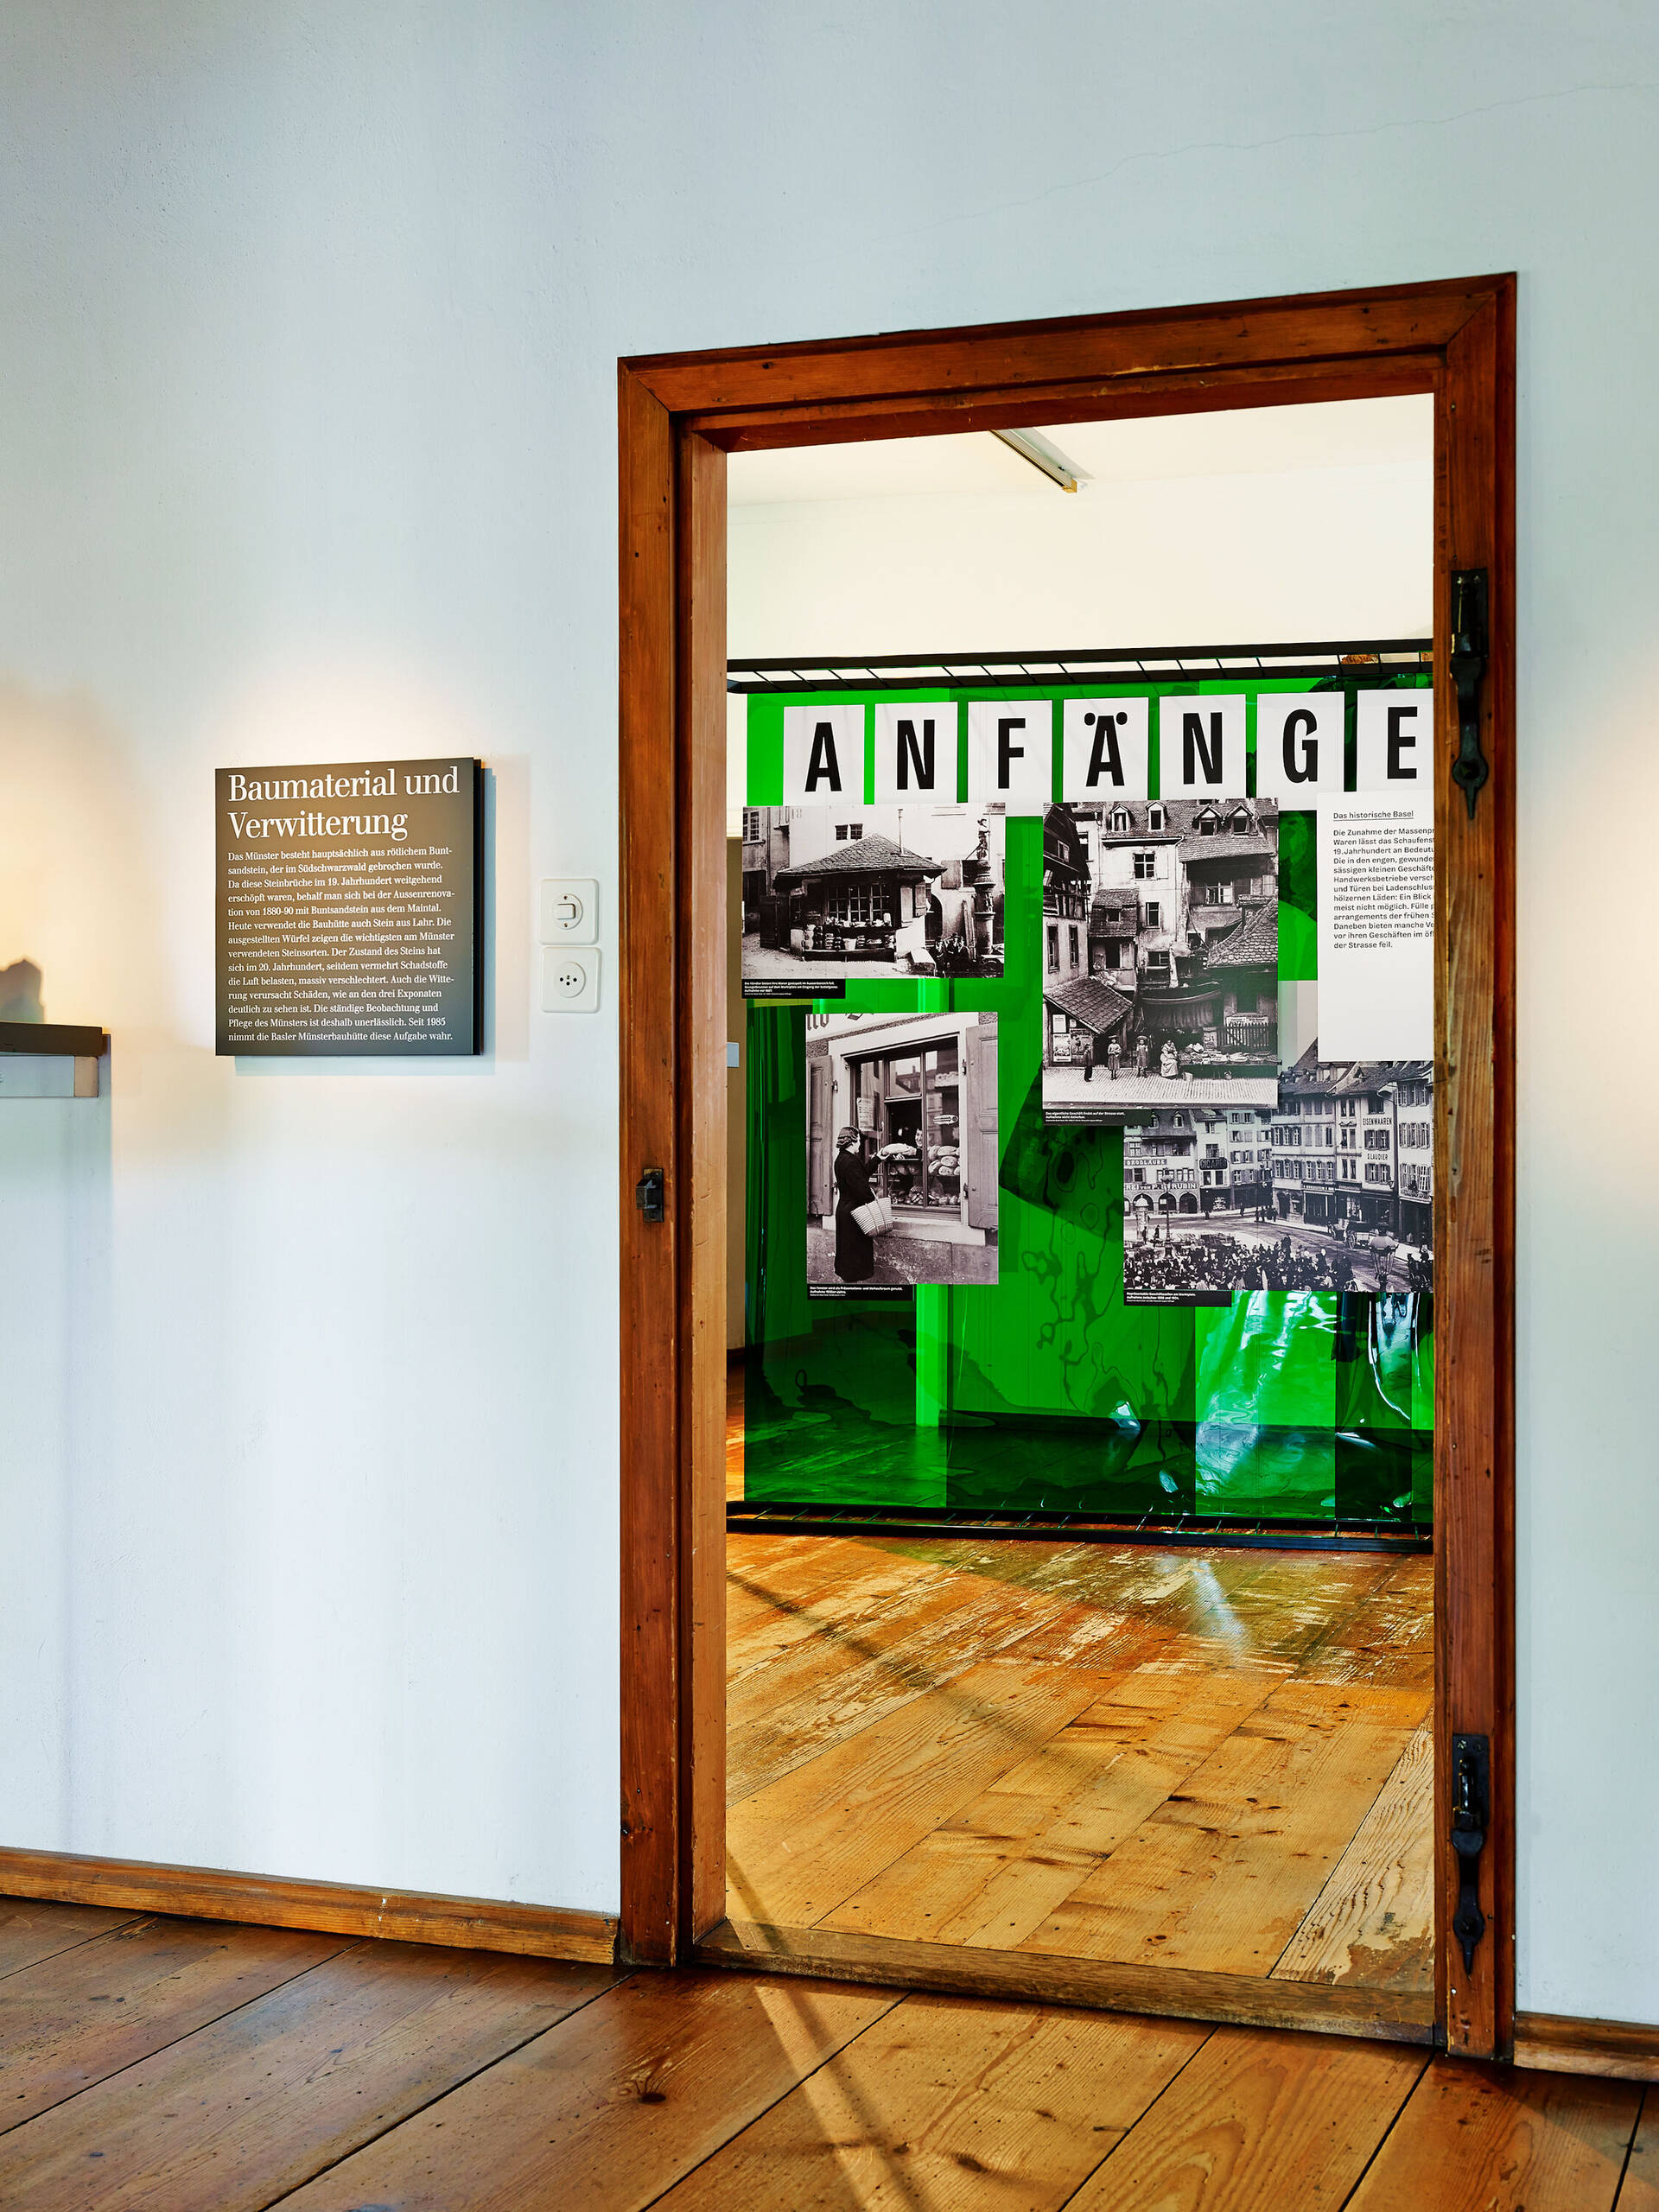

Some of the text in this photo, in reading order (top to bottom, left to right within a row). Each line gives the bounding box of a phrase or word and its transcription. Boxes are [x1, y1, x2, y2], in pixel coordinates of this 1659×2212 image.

[804, 707, 1417, 792] ANFÄNGE
[228, 766, 461, 802] Baumaterial und
[227, 810, 409, 842] Verwitterung
[228, 852, 244, 861] Das
[245, 851, 279, 861] Münster
[280, 850, 310, 859] besteht
[311, 848, 369, 861] hauptsächlich
[386, 847, 427, 856] rötlichem
[429, 846, 453, 855] Bunt-
[1398, 855, 1434, 864] gewunde
[227, 861, 443, 875] sandstein, der im Südschwarzwald gebrochen wurde.
[1333, 866, 1367, 874] sässigen
[228, 874, 442, 889] Da diese Steinbrüche im 19. Jahrhundert weitgehend
[1333, 874, 1408, 883] Handwerksbetriebe
[1385, 883, 1434, 892] Ladenschlus
[227, 893, 265, 904] erschöpft
[296, 892, 323, 901] behalf
[344, 891, 361, 900] sich
[363, 890, 376, 899] bei
[377, 890, 392, 899] der
[393, 890, 455, 899] Aussenrenova-
[228, 907, 244, 917] tion
[263, 906, 294, 916] 1880-90
[295, 906, 309, 915] mit
[311, 905, 369, 914] Buntsandstein
[386, 904, 405, 913] dem
[407, 903, 442, 912] Maintal.
[1377, 903, 1409, 912] möglich.
[228, 921, 252, 931] Heute
[253, 920, 297, 930] verwendet
[297, 920, 311, 929] die
[312, 919, 350, 929] Bauhütte
[351, 918, 372, 928] auch
[372, 918, 394, 928] Stein
[412, 918, 435, 927] Lahr.
[436, 917, 452, 926] Die
[1333, 913, 1388, 922] arrangements
[227, 935, 280, 946] ausgestellten
[282, 934, 310, 944] Würfel
[311, 933, 339, 944] zeigen
[340, 933, 353, 942] die
[354, 932, 403, 944] wichtigsten
[419, 931, 455, 941] Münster
[228, 946, 442, 958] verwendeten Steinsorten. Der Zustand des Steins hat
[228, 960, 448, 972] sich im 20. Jahrhundert, seitdem vermehrt Schadstoffe
[228, 1004, 261, 1014] deutlich
[273, 1004, 298, 1014] sehen
[300, 1004, 312, 1013] ist.
[314, 1004, 328, 1013] Die
[329, 1003, 365, 1014] ständige
[365, 1003, 421, 1014] Beobachtung
[422, 1002, 439, 1012] und
[228, 1016, 446, 1030] Pflege des Münsters ist deshalb unerlässlich. Seit 1985
[228, 1031, 453, 1043] nimmt die Basler Münsterbauhütte diese Aufgabe wahr.
